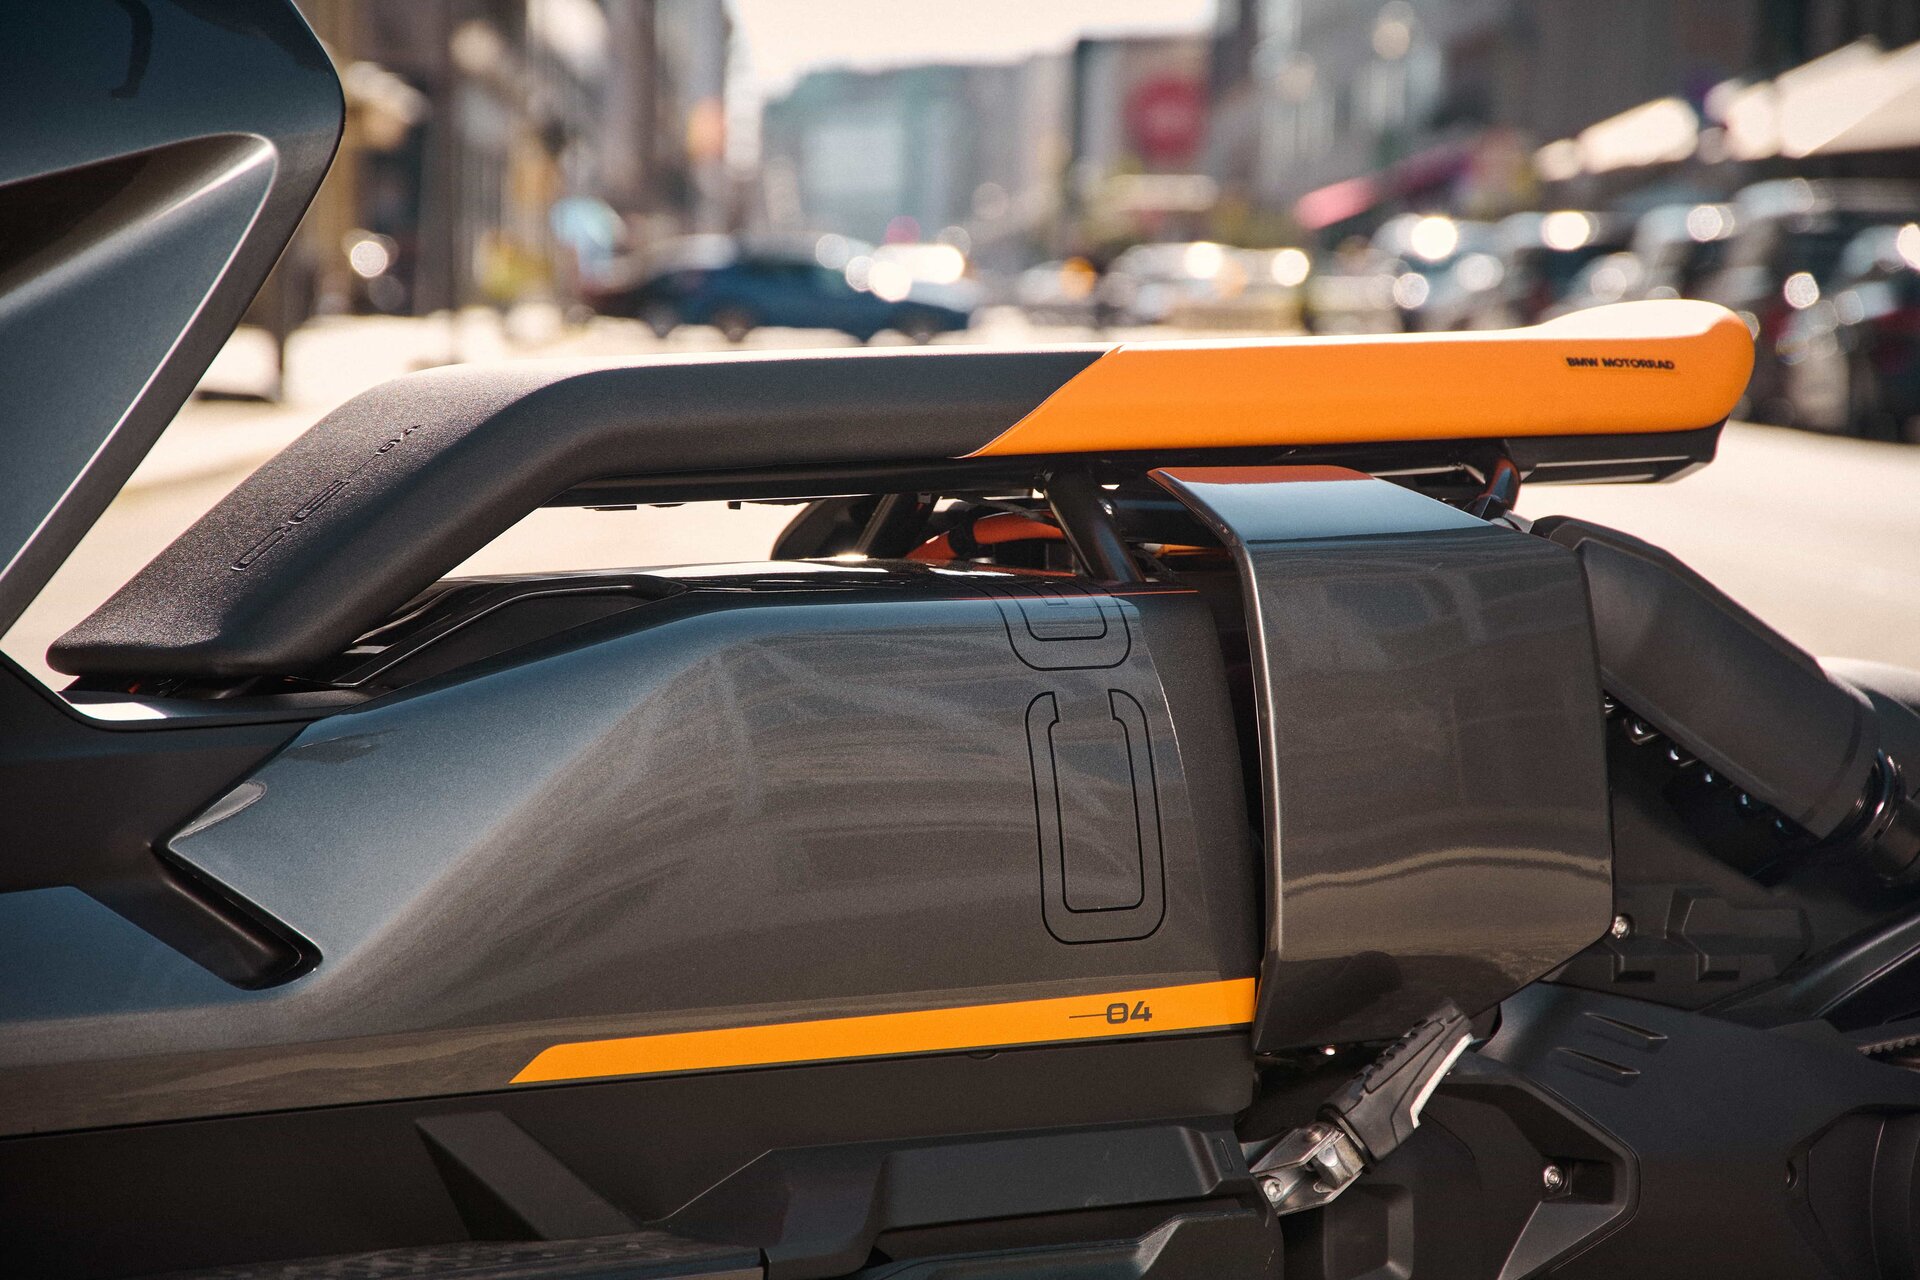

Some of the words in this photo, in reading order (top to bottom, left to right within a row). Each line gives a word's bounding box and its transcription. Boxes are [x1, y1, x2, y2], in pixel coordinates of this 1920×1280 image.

[1566, 357, 1599, 367] BMW
[1602, 358, 1675, 370] MOTORRAD
[1106, 1000, 1153, 1025] 04
